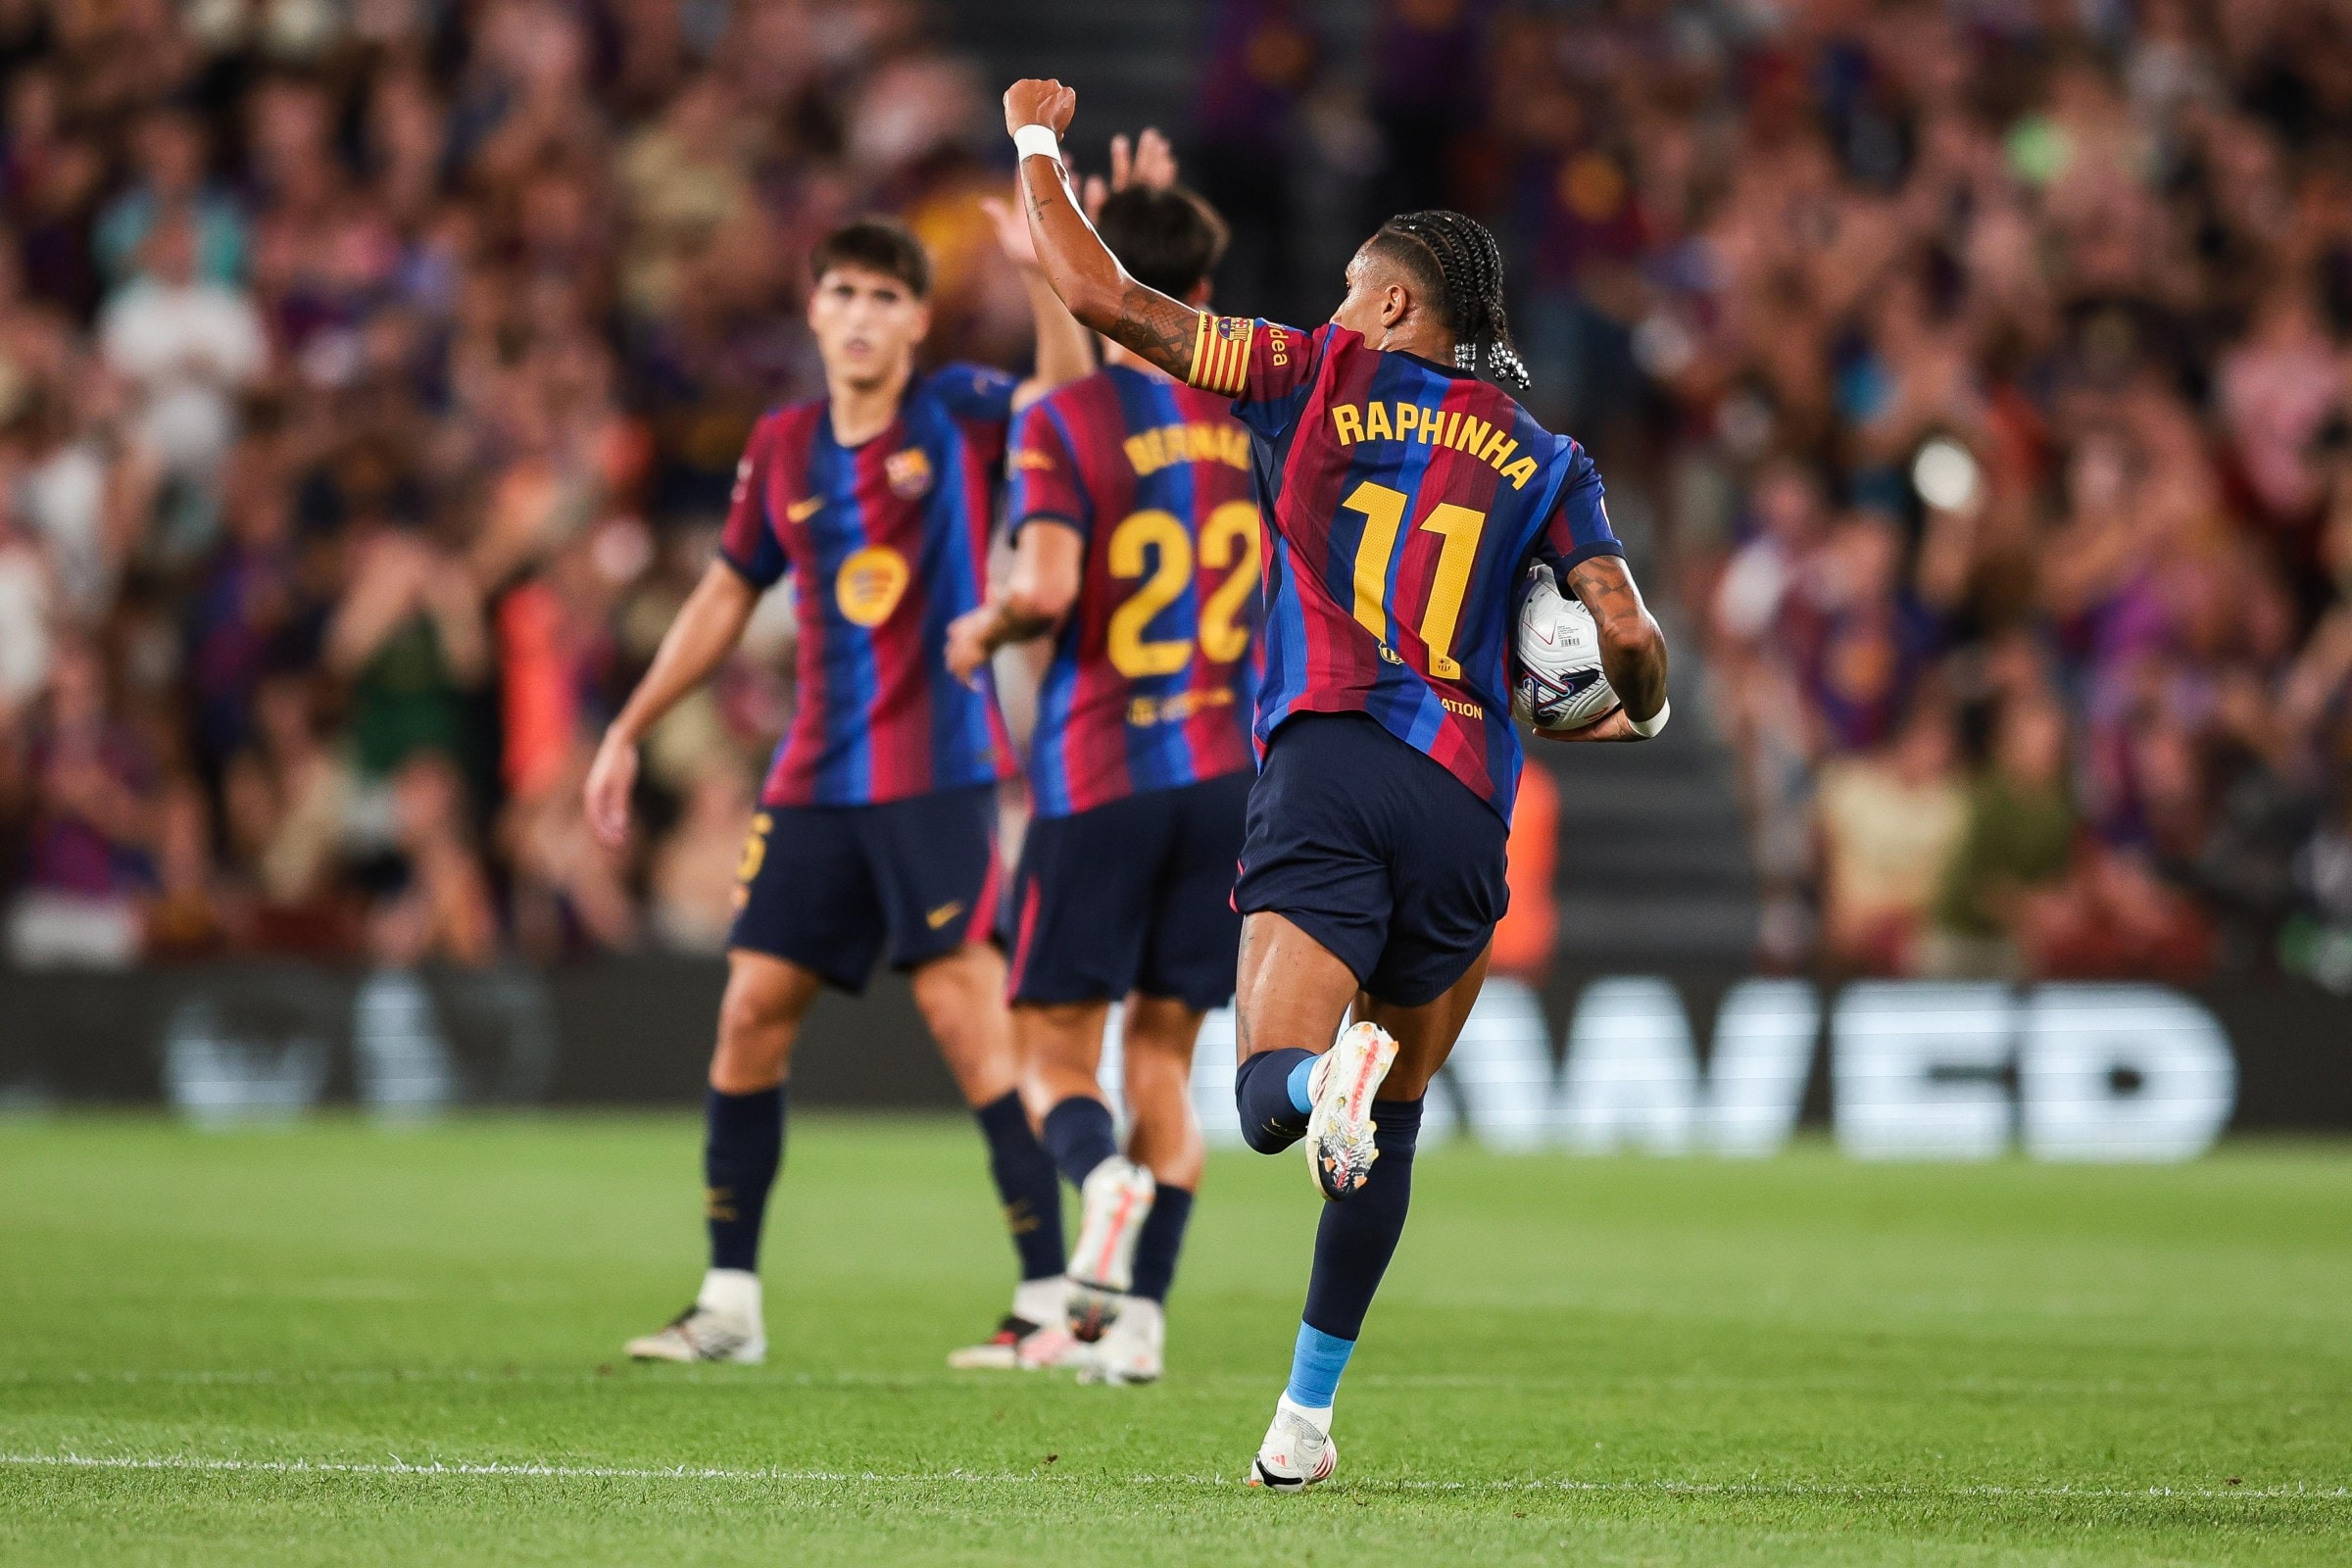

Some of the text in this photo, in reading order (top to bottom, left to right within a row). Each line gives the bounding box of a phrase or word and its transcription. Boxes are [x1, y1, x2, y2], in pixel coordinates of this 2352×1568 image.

[1332, 402, 1539, 491] RAPHINHA
[1108, 501, 1261, 678] 22
[1342, 481, 1487, 680] 11
